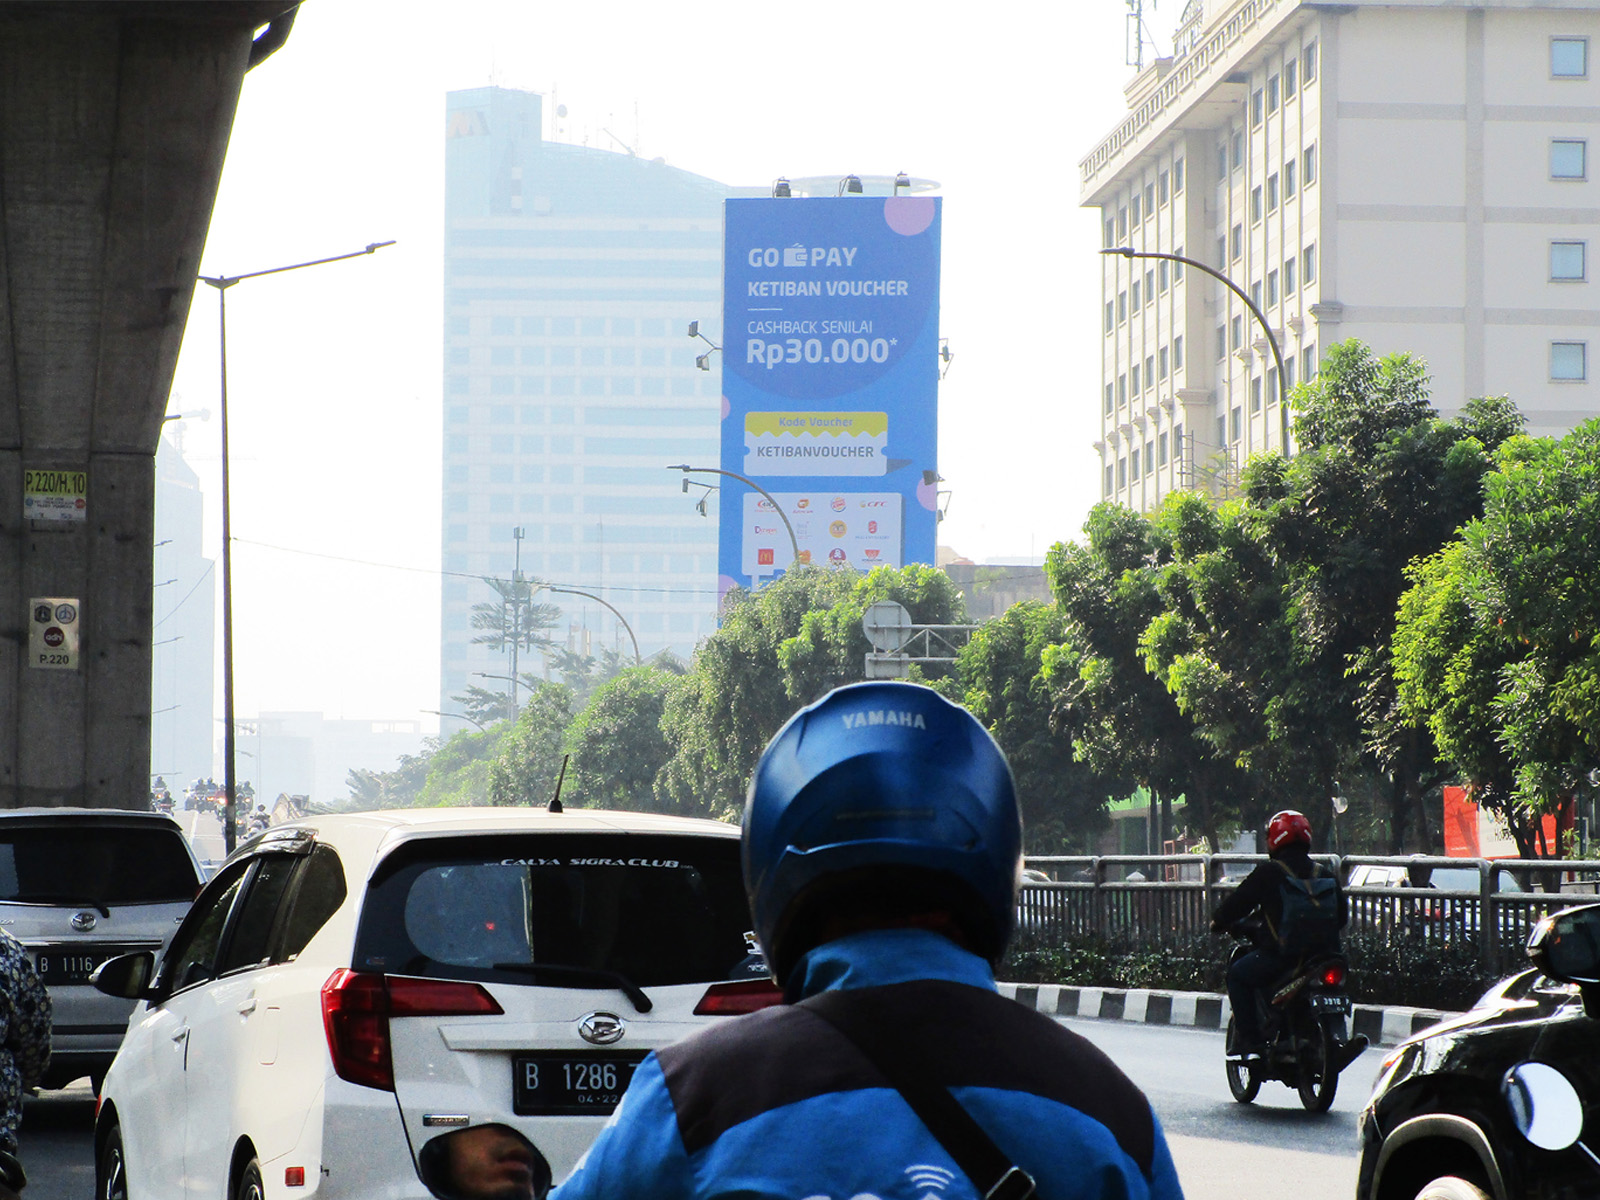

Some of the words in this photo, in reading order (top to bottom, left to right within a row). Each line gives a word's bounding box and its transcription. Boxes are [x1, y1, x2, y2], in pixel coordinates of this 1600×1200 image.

[748, 247, 779, 267] GO
[811, 247, 858, 267] PAY
[748, 281, 821, 297] KETIBAN
[826, 280, 909, 296] VOUCHER
[747, 320, 818, 334] CASHBACK
[821, 320, 873, 334] SENILAI
[779, 417, 806, 427] Kode
[809, 417, 853, 427] Voucher
[757, 446, 874, 458] KETIBANVOUCHER
[25, 472, 85, 494] P.220/H.10
[40, 654, 70, 665] P.220
[841, 710, 926, 730] YAMAHA
[500, 858, 561, 866] CALYA
[40, 956, 48, 973] B
[63, 956, 93, 972] 1116
[525, 1063, 539, 1090] B
[563, 1063, 617, 1090] 1286
